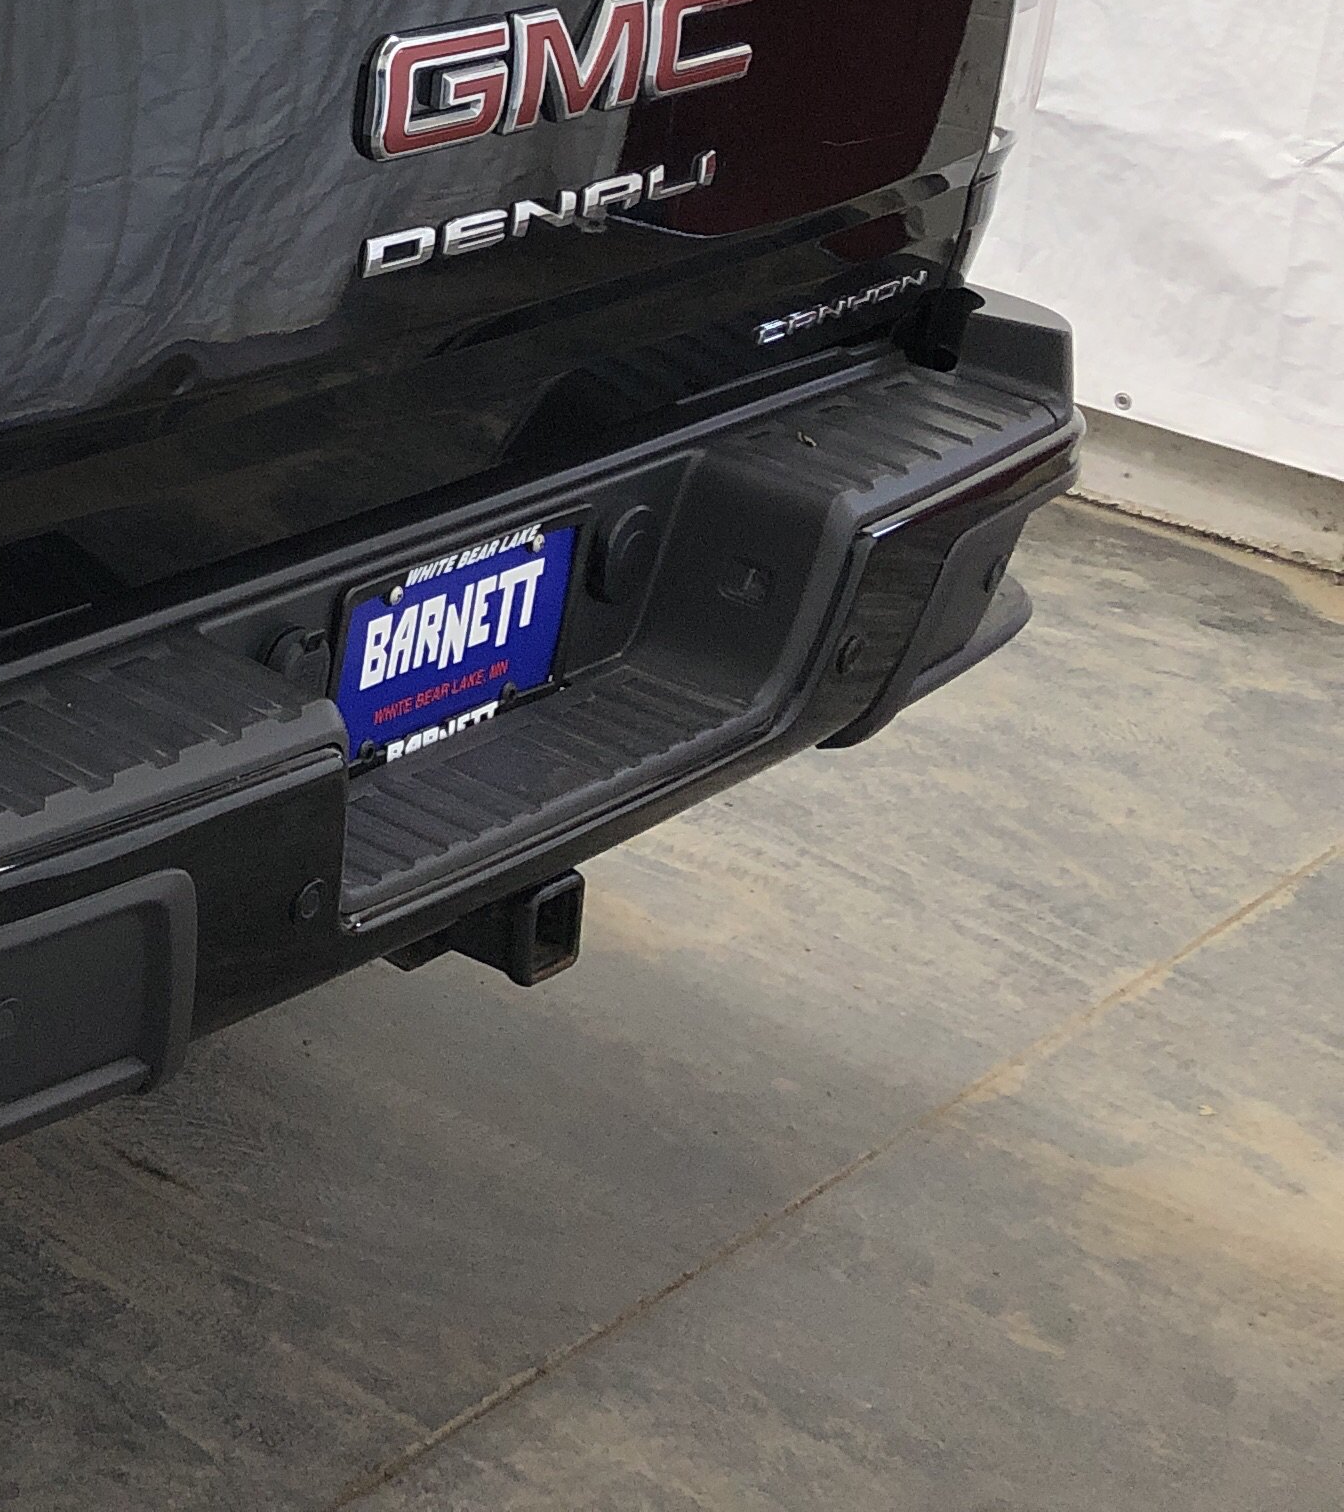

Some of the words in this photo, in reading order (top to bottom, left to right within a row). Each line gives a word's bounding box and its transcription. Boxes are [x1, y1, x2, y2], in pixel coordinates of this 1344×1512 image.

[359, 149, 716, 278] DENALI
[404, 554, 459, 588] WHITE
[456, 539, 500, 569] BEAR
[498, 523, 542, 554] LAKE
[359, 557, 545, 691] BARNETT
[374, 696, 413, 725] WHITE
[415, 683, 451, 709] BEAR
[488, 659, 509, 680] MN
